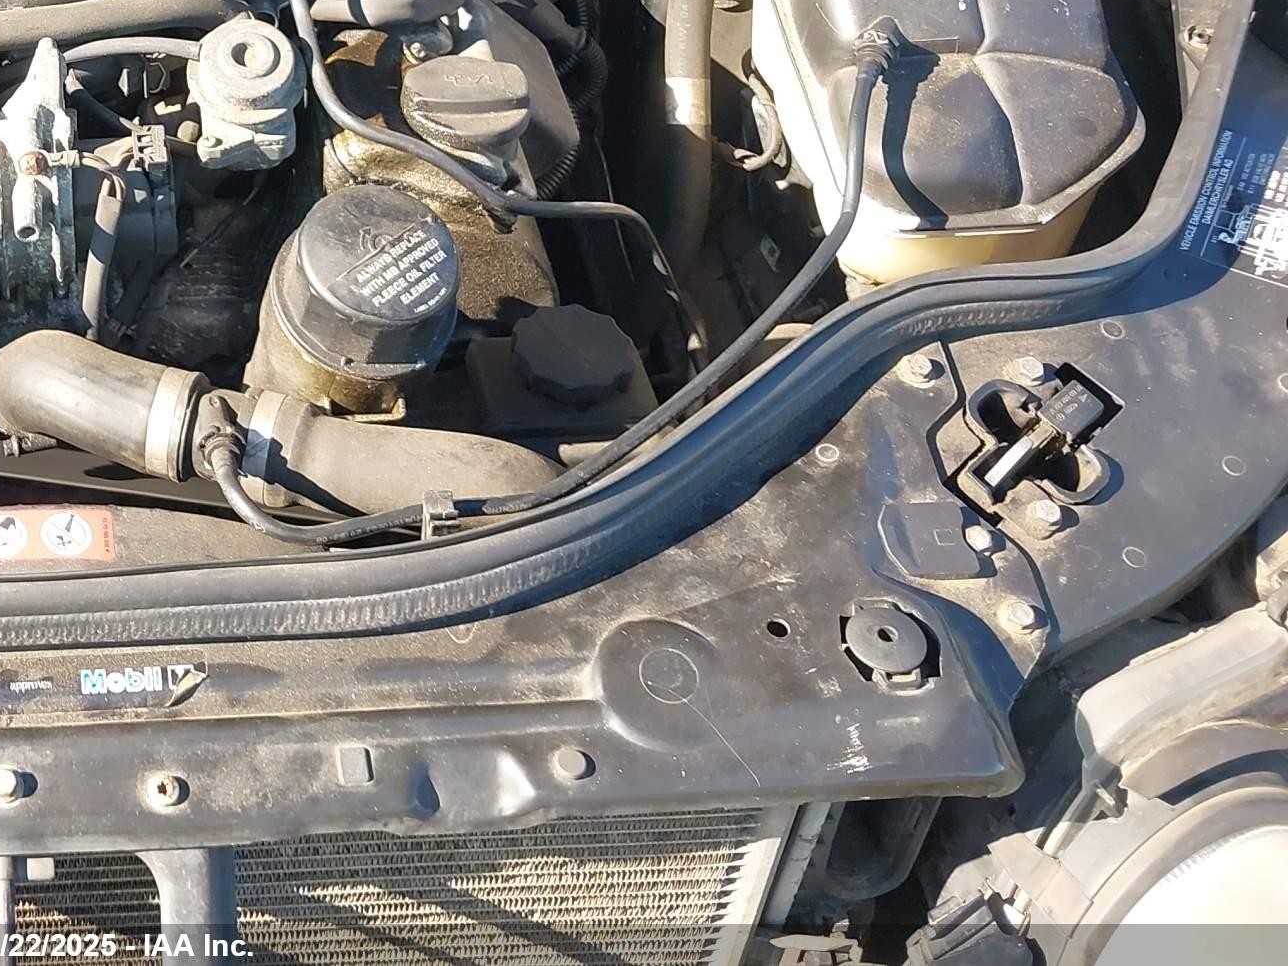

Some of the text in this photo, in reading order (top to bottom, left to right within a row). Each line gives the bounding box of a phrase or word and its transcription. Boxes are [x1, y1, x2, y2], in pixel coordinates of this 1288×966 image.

[1180, 223, 1197, 250] VEHICLE
[1191, 195, 1206, 225] EMISSION
[1203, 167, 1218, 194] CONTROL
[1213, 130, 1233, 167] INFORMATION
[356, 229, 426, 283] ALWAYS REPLACE
[359, 238, 439, 297] WITH MB APPROVED
[372, 277, 408, 307] FLEECE
[406, 268, 423, 282] OIL
[419, 250, 447, 272] FILTER
[399, 272, 440, 305] ELEMENT
[80, 666, 163, 694] Mobil
